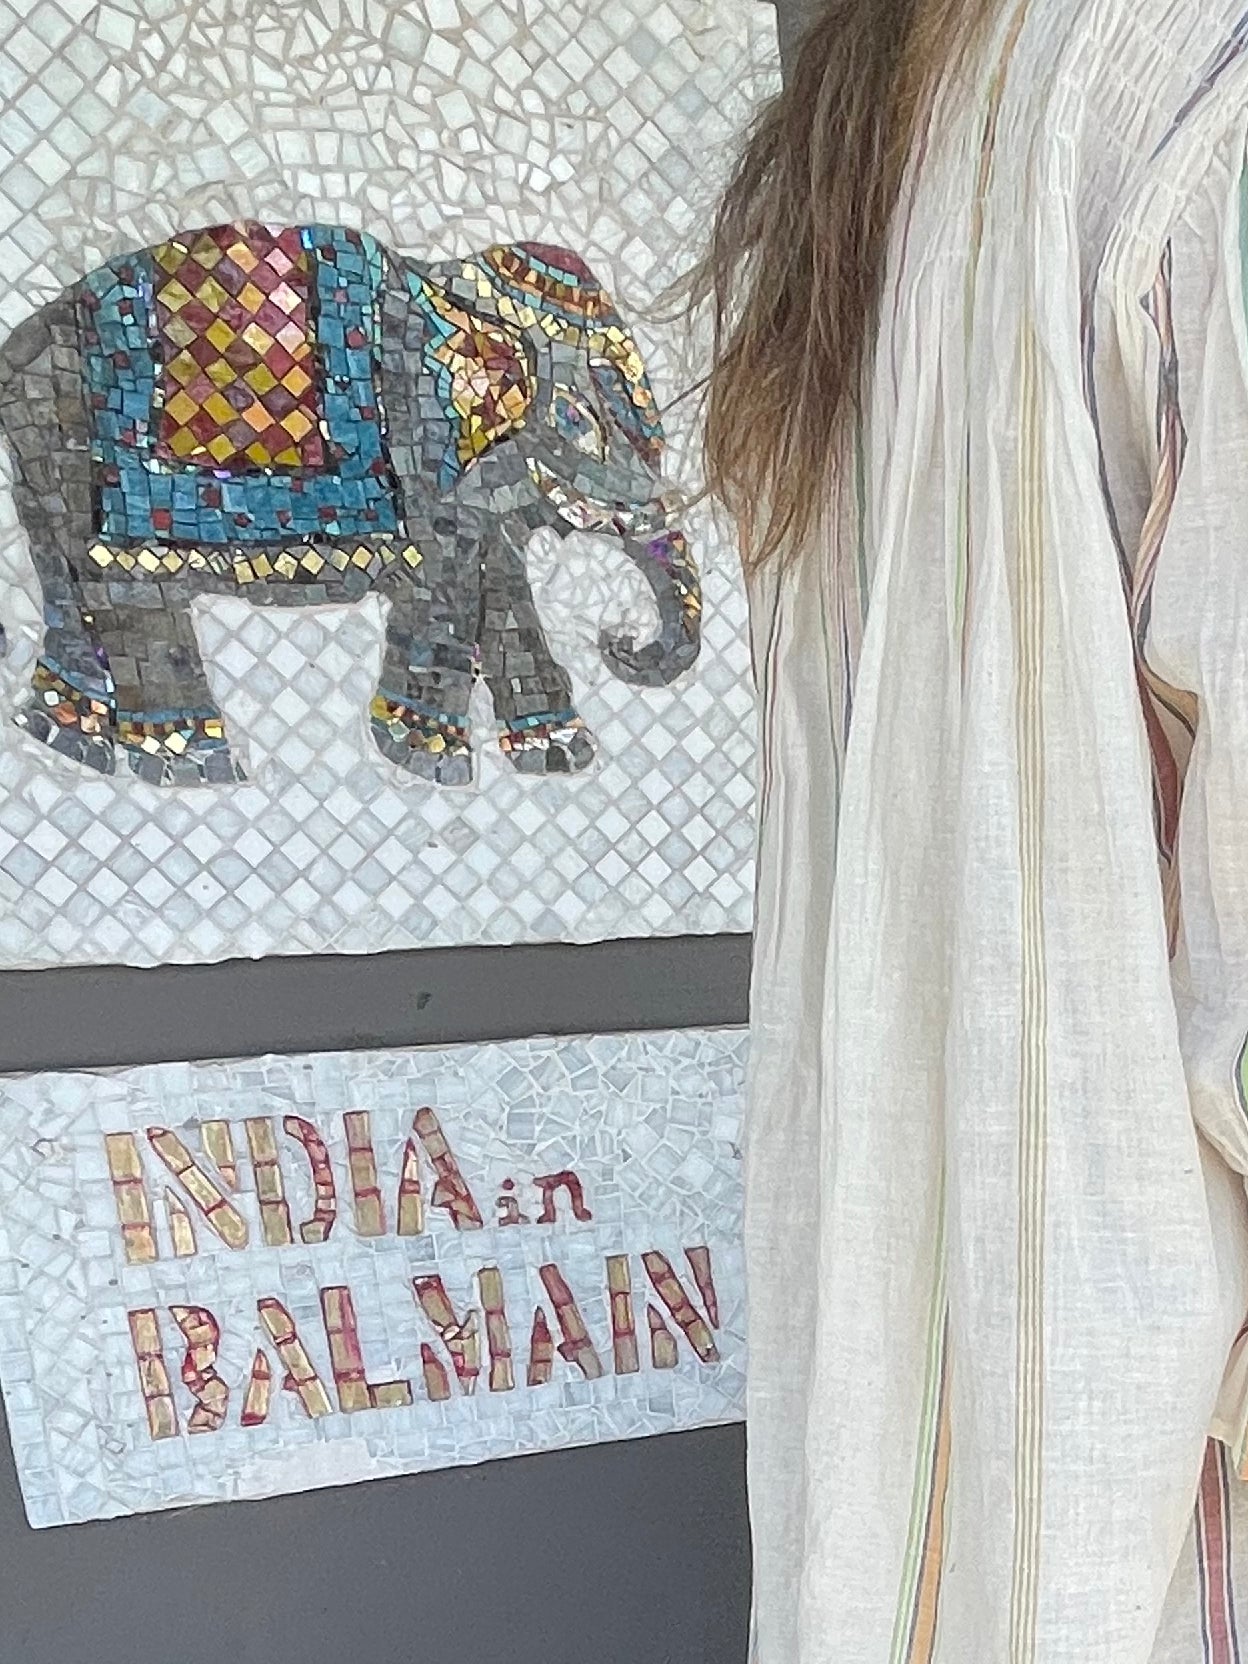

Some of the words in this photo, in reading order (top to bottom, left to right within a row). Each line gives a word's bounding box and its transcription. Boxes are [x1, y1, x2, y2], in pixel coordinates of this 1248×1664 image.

[104, 1107, 484, 1264] INDIA
[496, 1170, 593, 1226] in
[128, 1245, 721, 1440] BALMAIN
